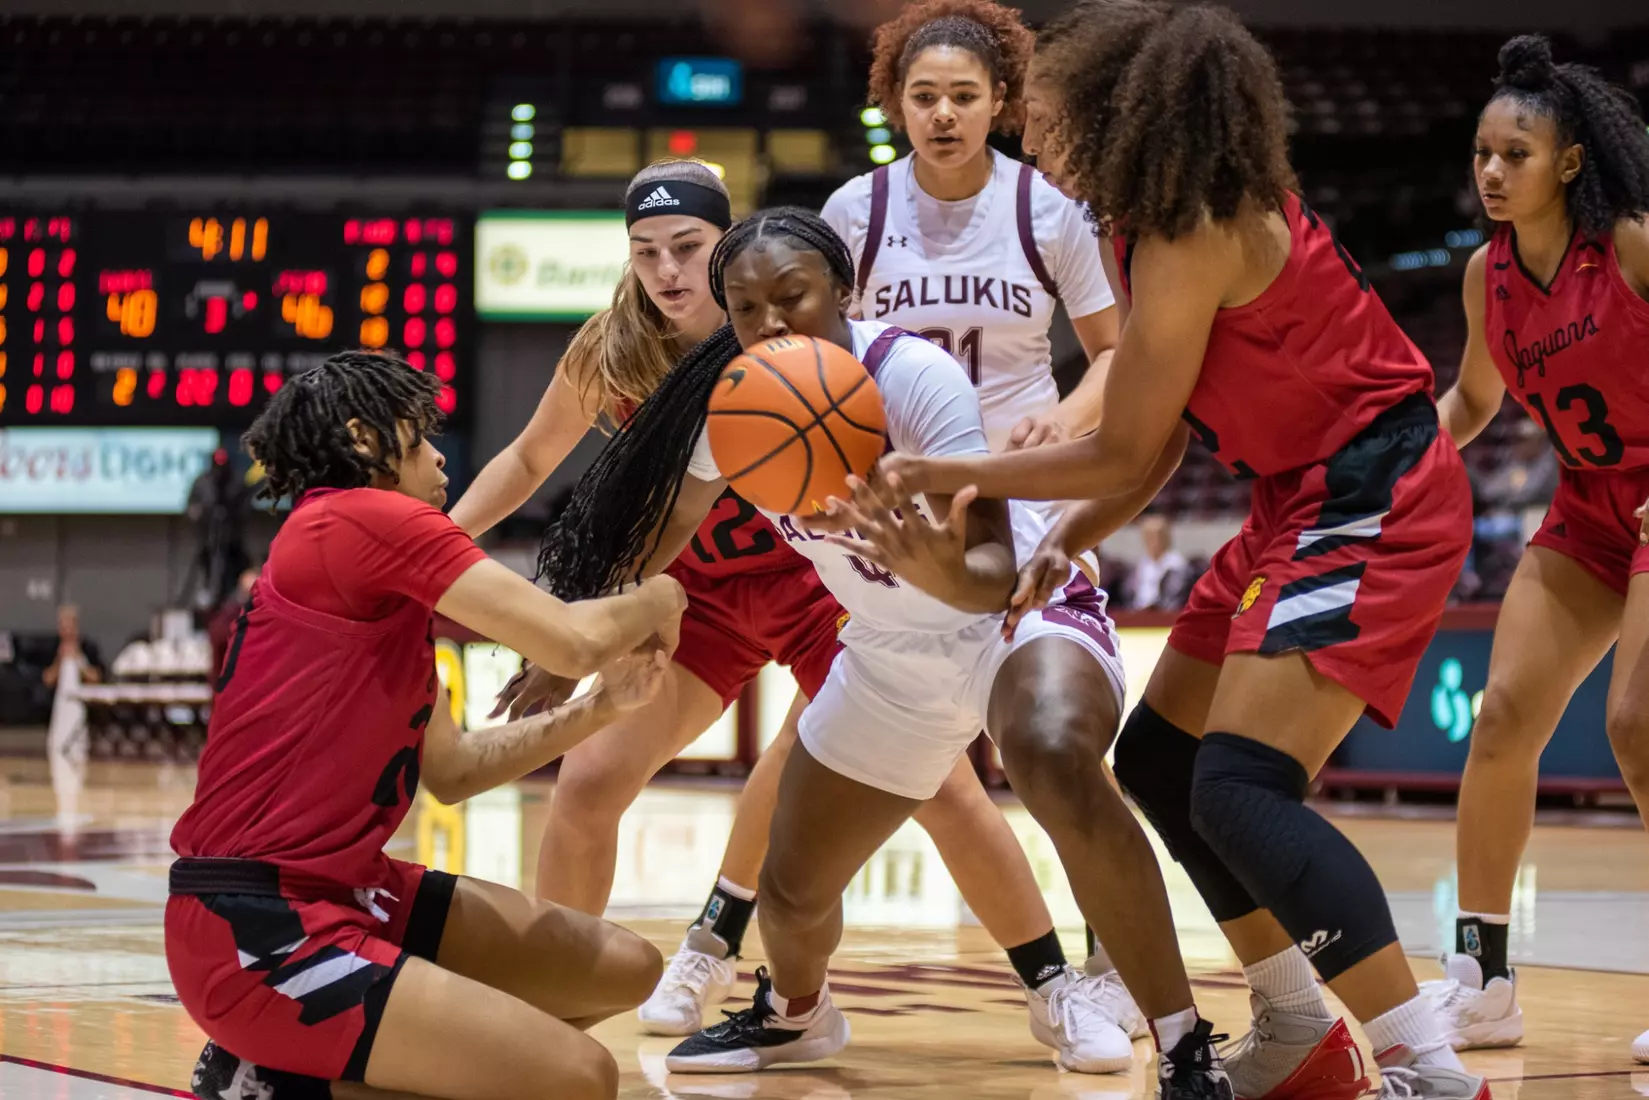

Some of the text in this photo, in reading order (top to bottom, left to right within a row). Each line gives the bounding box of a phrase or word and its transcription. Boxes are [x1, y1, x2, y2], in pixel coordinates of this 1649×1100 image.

[638, 198, 680, 211] adidas
[875, 275, 1032, 319] SALUKIS
[1504, 314, 1599, 388] Jaguars
[1526, 383, 1625, 467] 13
